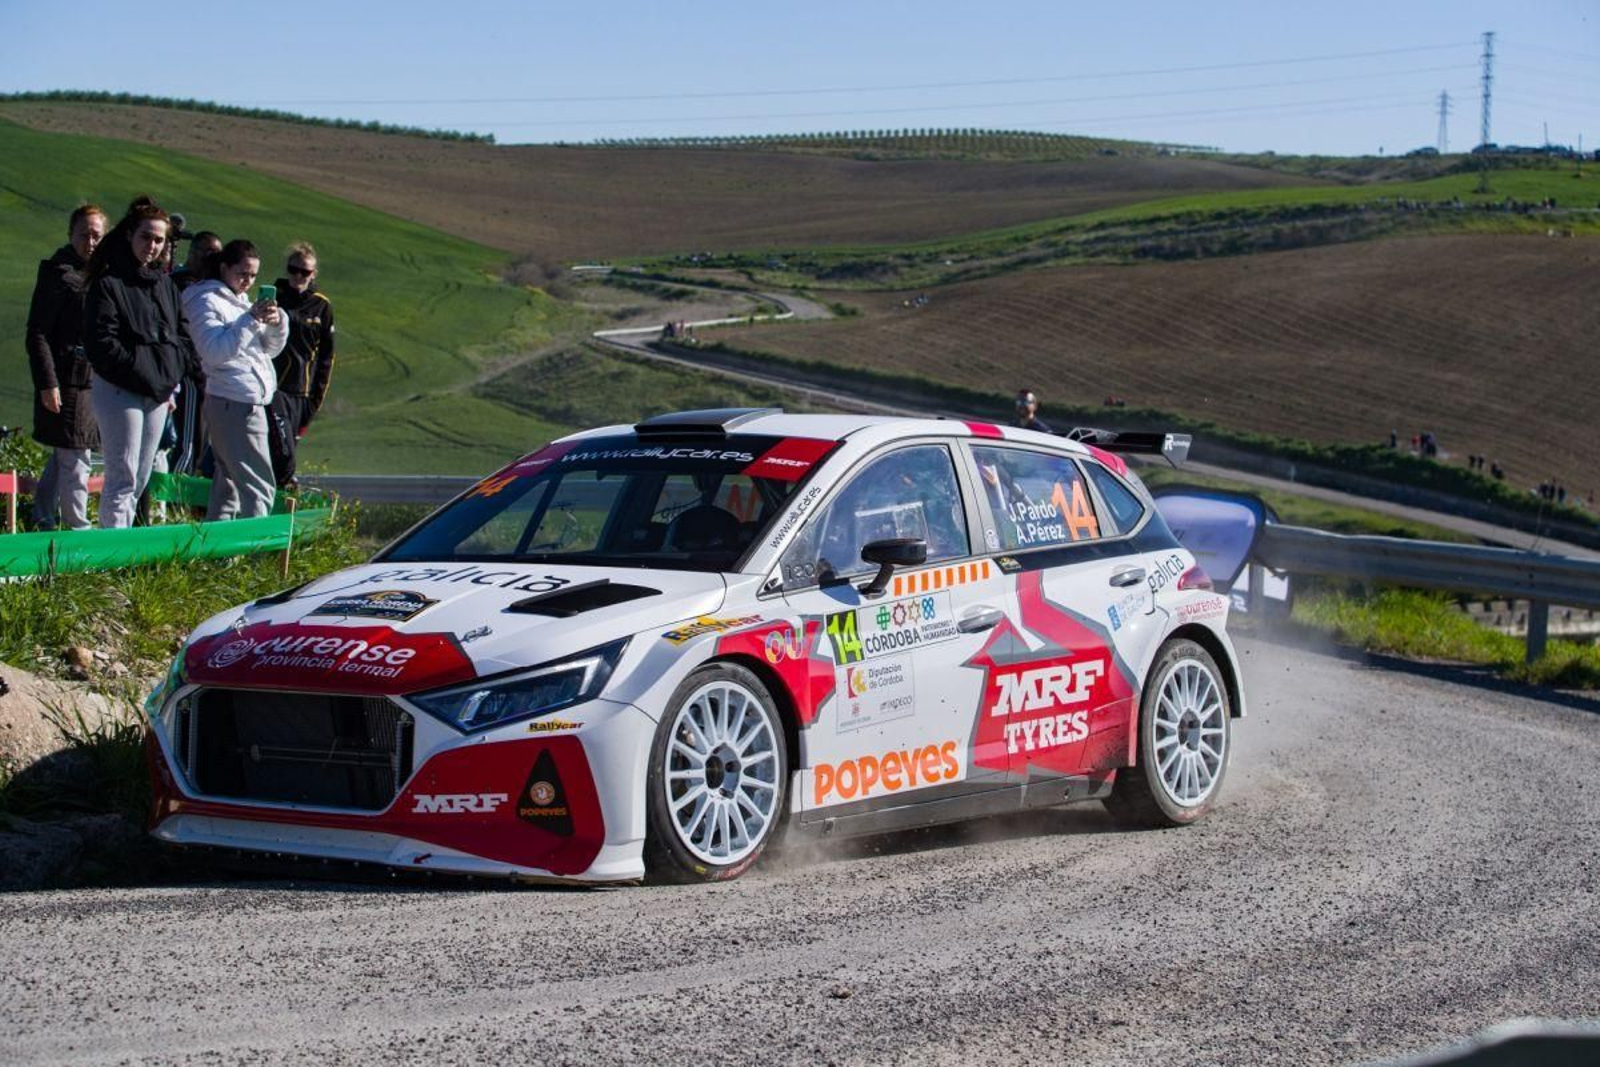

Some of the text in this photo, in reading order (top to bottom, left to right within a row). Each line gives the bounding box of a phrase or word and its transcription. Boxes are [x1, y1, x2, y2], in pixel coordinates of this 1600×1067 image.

[1009, 500, 1057, 522] J.Pardo
[1051, 480, 1100, 541] 14
[1016, 523, 1066, 544] A.Pérez
[254, 634, 416, 665] ourense
[765, 629, 803, 664] OU
[827, 611, 862, 665] 14
[865, 627, 922, 654] CÓRDOBA
[251, 654, 404, 678] provincia termal
[869, 664, 902, 678] Diputación
[869, 675, 904, 689] de Córdoba
[991, 659, 1105, 717] MRF
[1003, 710, 1089, 755] TYRES
[412, 793, 508, 814] MRF
